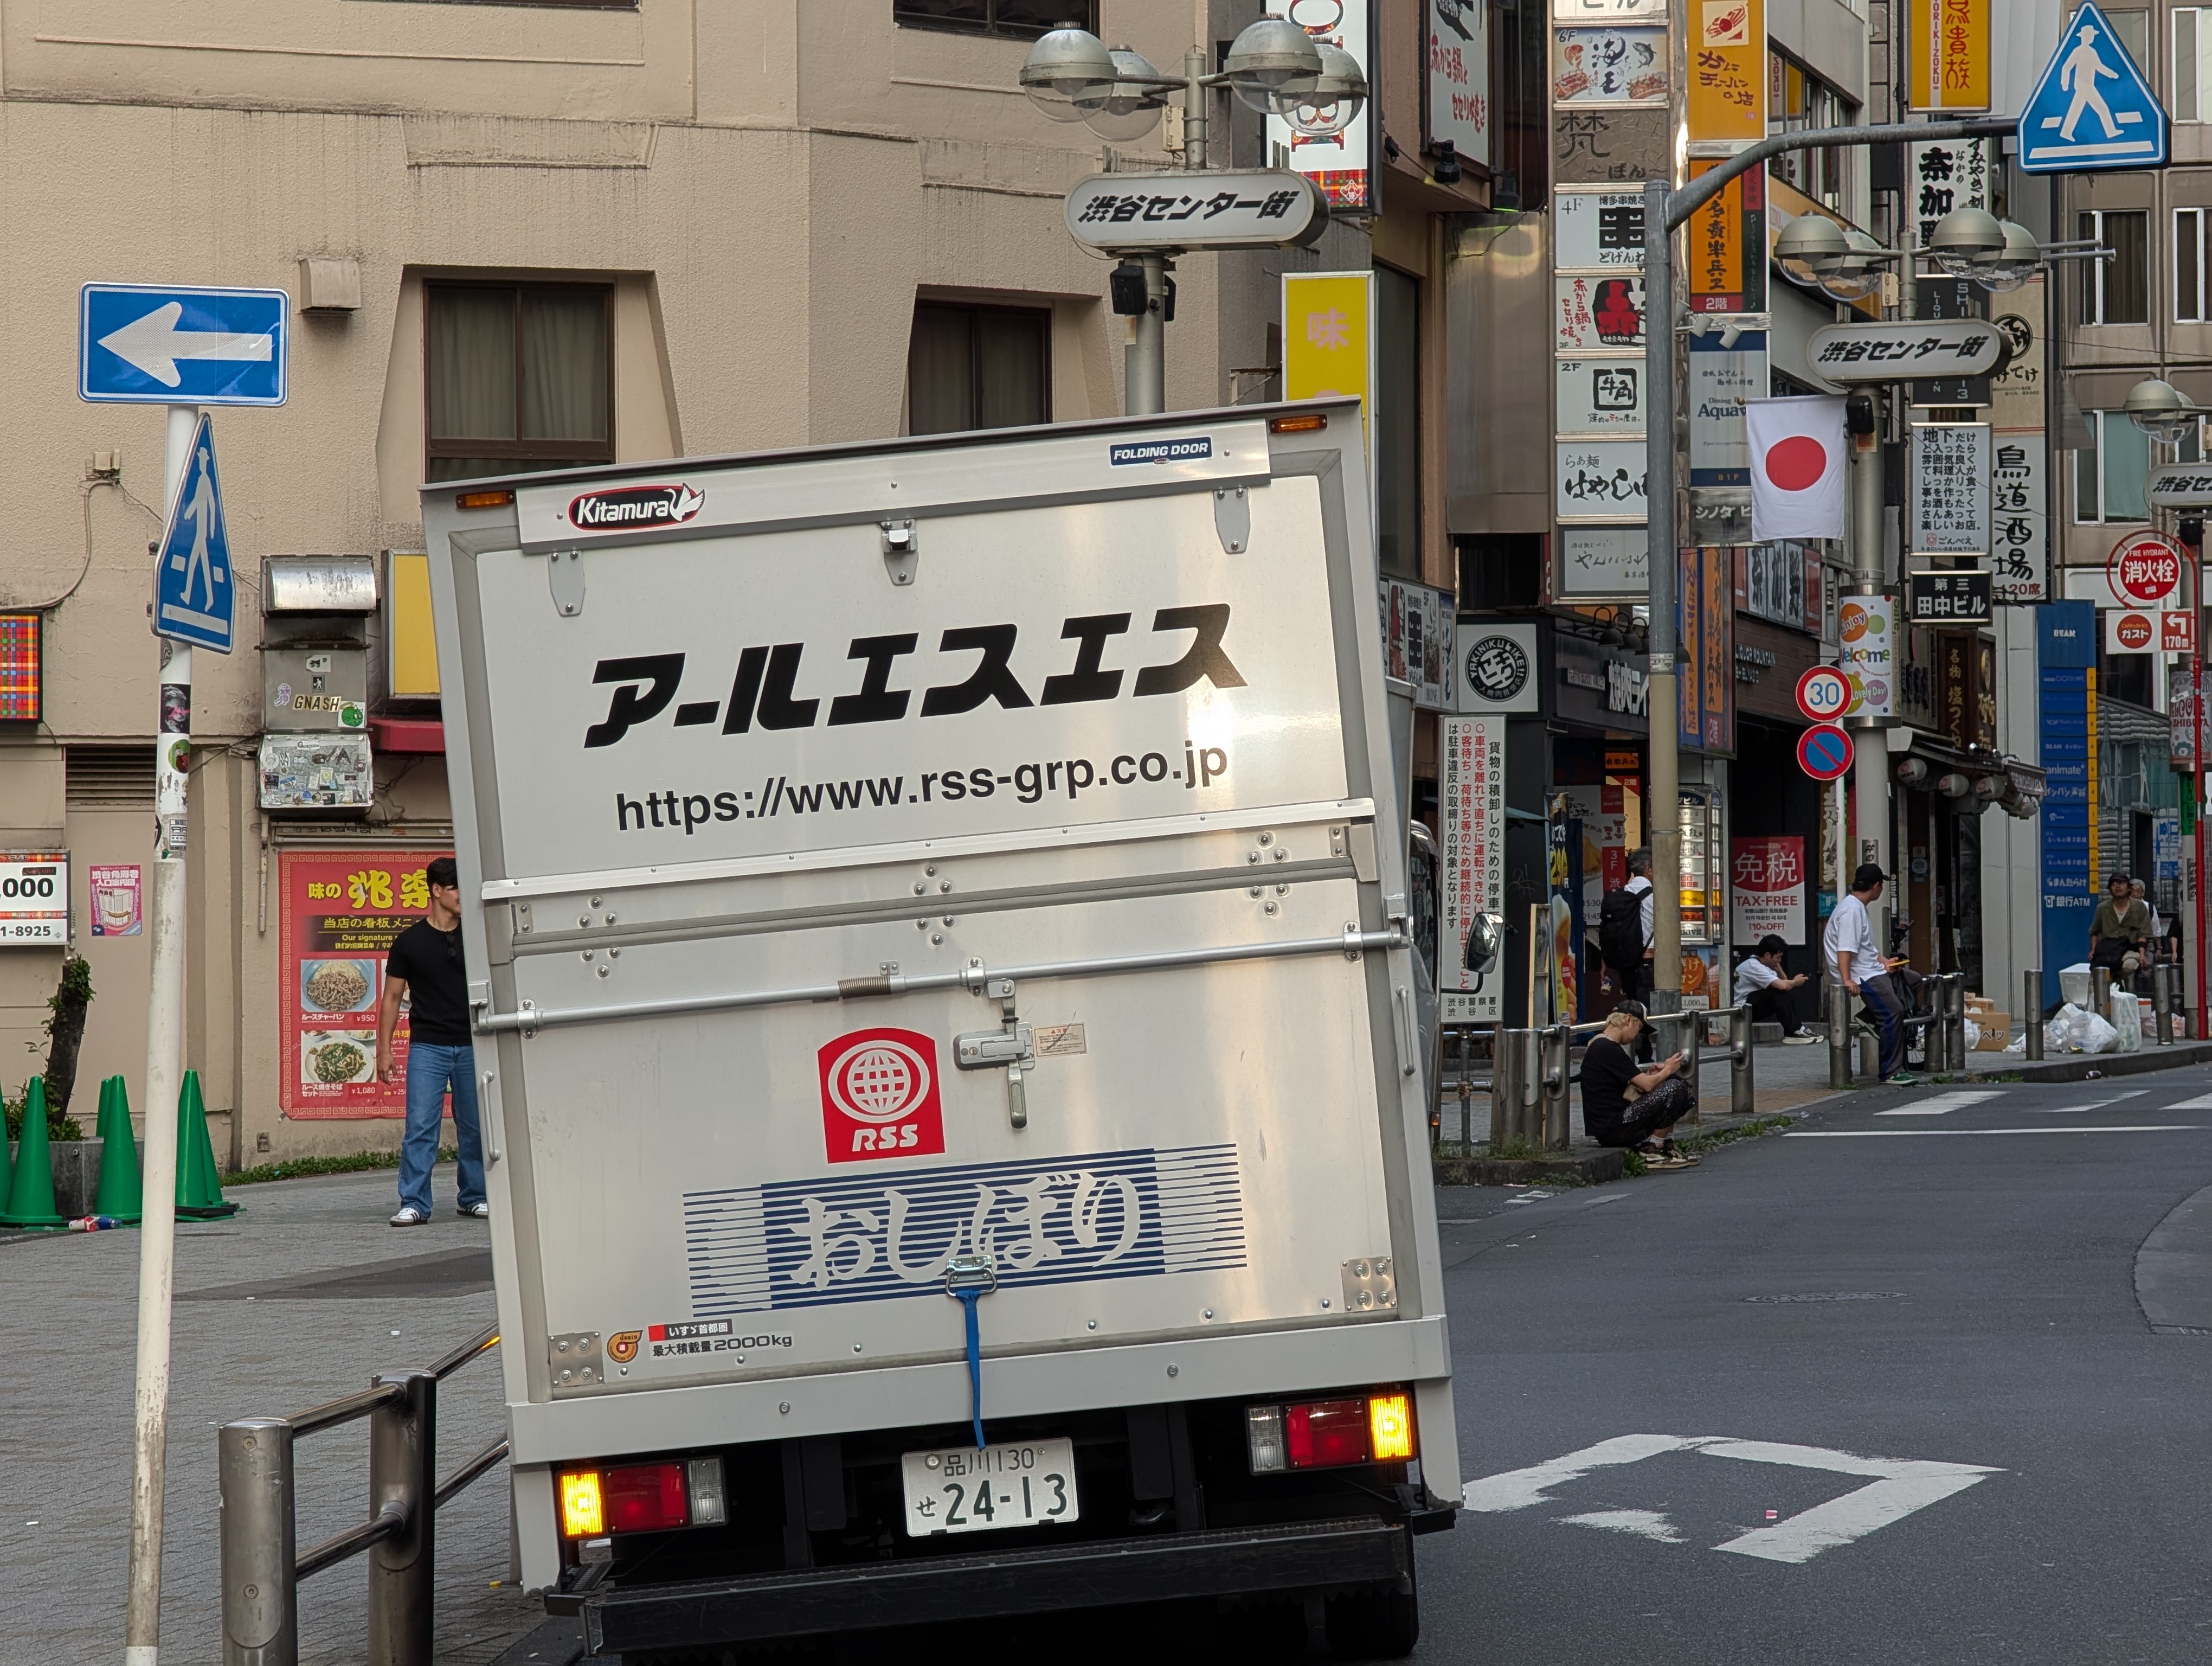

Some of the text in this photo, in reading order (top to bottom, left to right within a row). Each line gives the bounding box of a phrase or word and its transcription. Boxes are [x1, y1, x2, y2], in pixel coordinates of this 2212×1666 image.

[1559, 30, 1576, 42] 6F
[1697, 50, 1740, 72] かに
[1700, 72, 1748, 88] チャーハン
[1723, 91, 1754, 106] の店
[1556, 111, 1611, 159] 梵
[1956, 150, 1965, 184] なかの
[1078, 190, 1300, 223] 渋谷センター街
[1561, 197, 1584, 215] 4F
[1573, 278, 1592, 331] 赤から鍋と
[1706, 298, 1727, 310] 2階
[1306, 307, 1349, 351] 味
[1560, 298, 1583, 347] セセリ焼き
[1817, 335, 1990, 364] 渋谷センター街
[1562, 363, 1581, 371] 2F
[1599, 376, 1633, 401] 牛角
[1922, 428, 1977, 444] 地下だけ
[1114, 442, 1208, 460] FOLDING DOOR
[1922, 444, 1976, 454] ど入ったら
[1566, 454, 1600, 469] らぁ麺
[1922, 454, 1975, 465] 雰囲気良く
[1922, 465, 1977, 476] て料理人が
[1922, 476, 1977, 487] しっかり食
[1921, 487, 1977, 498] 事を作って
[577, 497, 670, 524] Kitamura
[1921, 498, 1975, 509] お酒もたく
[1922, 509, 1976, 519] さんあって
[1992, 444, 2034, 581] 鳥道酒場
[1938, 536, 1973, 546] ごんべえ
[2125, 559, 2175, 584] 消火栓
[1934, 578, 1970, 591] 第三
[1918, 594, 1986, 615] 田中ビル
[1840, 612, 1866, 637] Enjoy
[2054, 629, 2076, 637] BEAM
[2121, 629, 2149, 639] ガスト
[2165, 635, 2189, 648] 170m
[1469, 639, 1505, 679] YAKINIKU
[1839, 646, 1891, 664] Welcome
[1949, 649, 1962, 679] 名物
[583, 603, 1249, 748] アールエスエス
[1809, 681, 1840, 706] 30
[1873, 686, 1887, 697] Day!
[294, 695, 340, 712] GNASH
[2046, 763, 2081, 774] animate
[618, 740, 1229, 836] https://www.rss-grp.co.jp
[1489, 741, 1501, 917] 貨物の積卸しのための停車
[1734, 851, 1798, 883] 免税
[0, 877, 54, 898] 000
[308, 882, 342, 899] 味の
[1735, 895, 1798, 906] TAX-FREE
[2056, 895, 2091, 907] 銀行ATM
[358, 933, 393, 943] signature
[1448, 996, 1497, 1007] 渋谷警察署
[1448, 1007, 1497, 1017] 渋谷区
[852, 1123, 920, 1152] RSS
[786, 1170, 1144, 1289] おしぼり
[668, 1322, 729, 1338] いすゞ首都圏
[944, 1447, 1036, 1477] 品川 130
[916, 1473, 1069, 1526] せ 24-13
